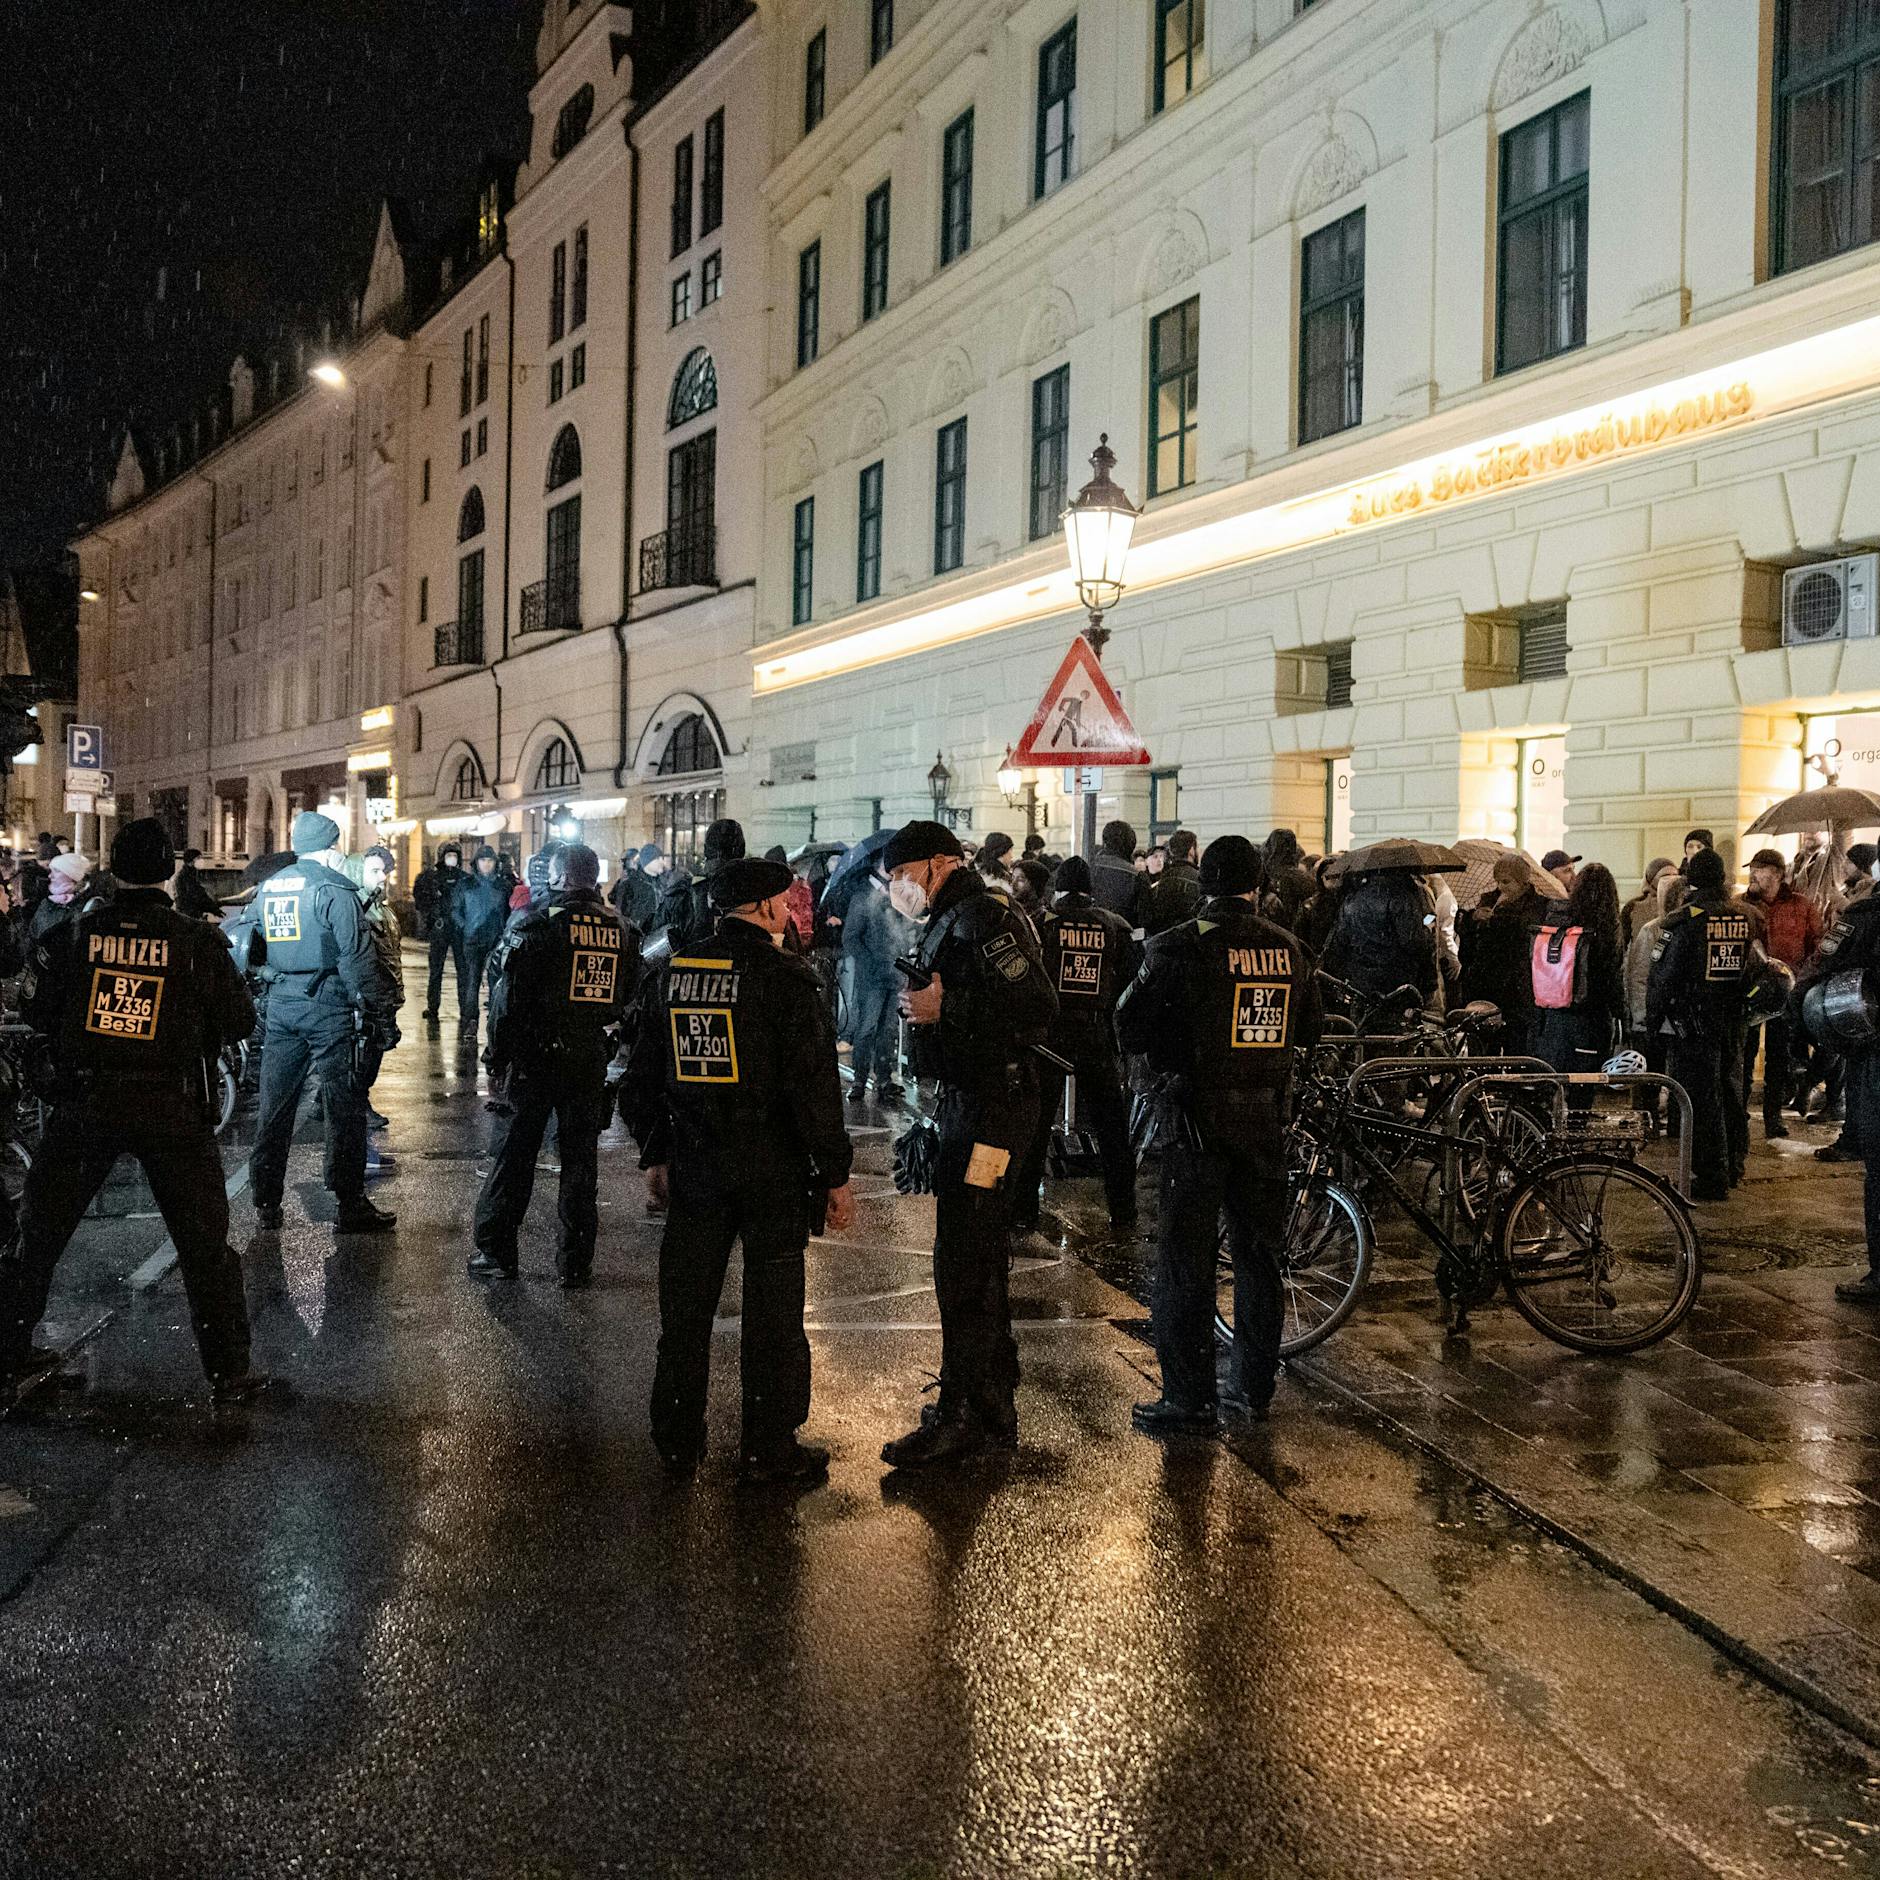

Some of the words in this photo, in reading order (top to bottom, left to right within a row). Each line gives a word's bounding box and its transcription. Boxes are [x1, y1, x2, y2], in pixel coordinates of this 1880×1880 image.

[73, 731, 92, 763] P
[274, 899, 289, 914] BY
[569, 924, 621, 949] POLIZEI
[1060, 929, 1105, 950] POLIZEI
[1706, 922, 1749, 939] POLIZEI
[88, 934, 169, 967] POLIZEI
[1720, 945, 1734, 957] BY
[587, 955, 605, 971] BY
[1074, 955, 1090, 968] BY
[1228, 948, 1292, 976] POLIZEI
[1711, 956, 1719, 967] M
[1721, 956, 1740, 967] 7333
[577, 969, 586, 983] M
[588, 969, 612, 986] 7333
[1064, 966, 1073, 978] M
[1074, 967, 1097, 980] 7333
[114, 977, 143, 998] BY
[668, 973, 740, 1003] POLIZEI
[96, 991, 111, 1011] M
[114, 995, 152, 1016] 7336
[1253, 989, 1276, 1007] BY
[99, 1014, 143, 1034] BeSi
[689, 1015, 713, 1035] BY
[1239, 1007, 1251, 1025] M
[1254, 1007, 1283, 1025] 7335
[679, 1035, 690, 1056] M
[693, 1035, 728, 1057] 7301
